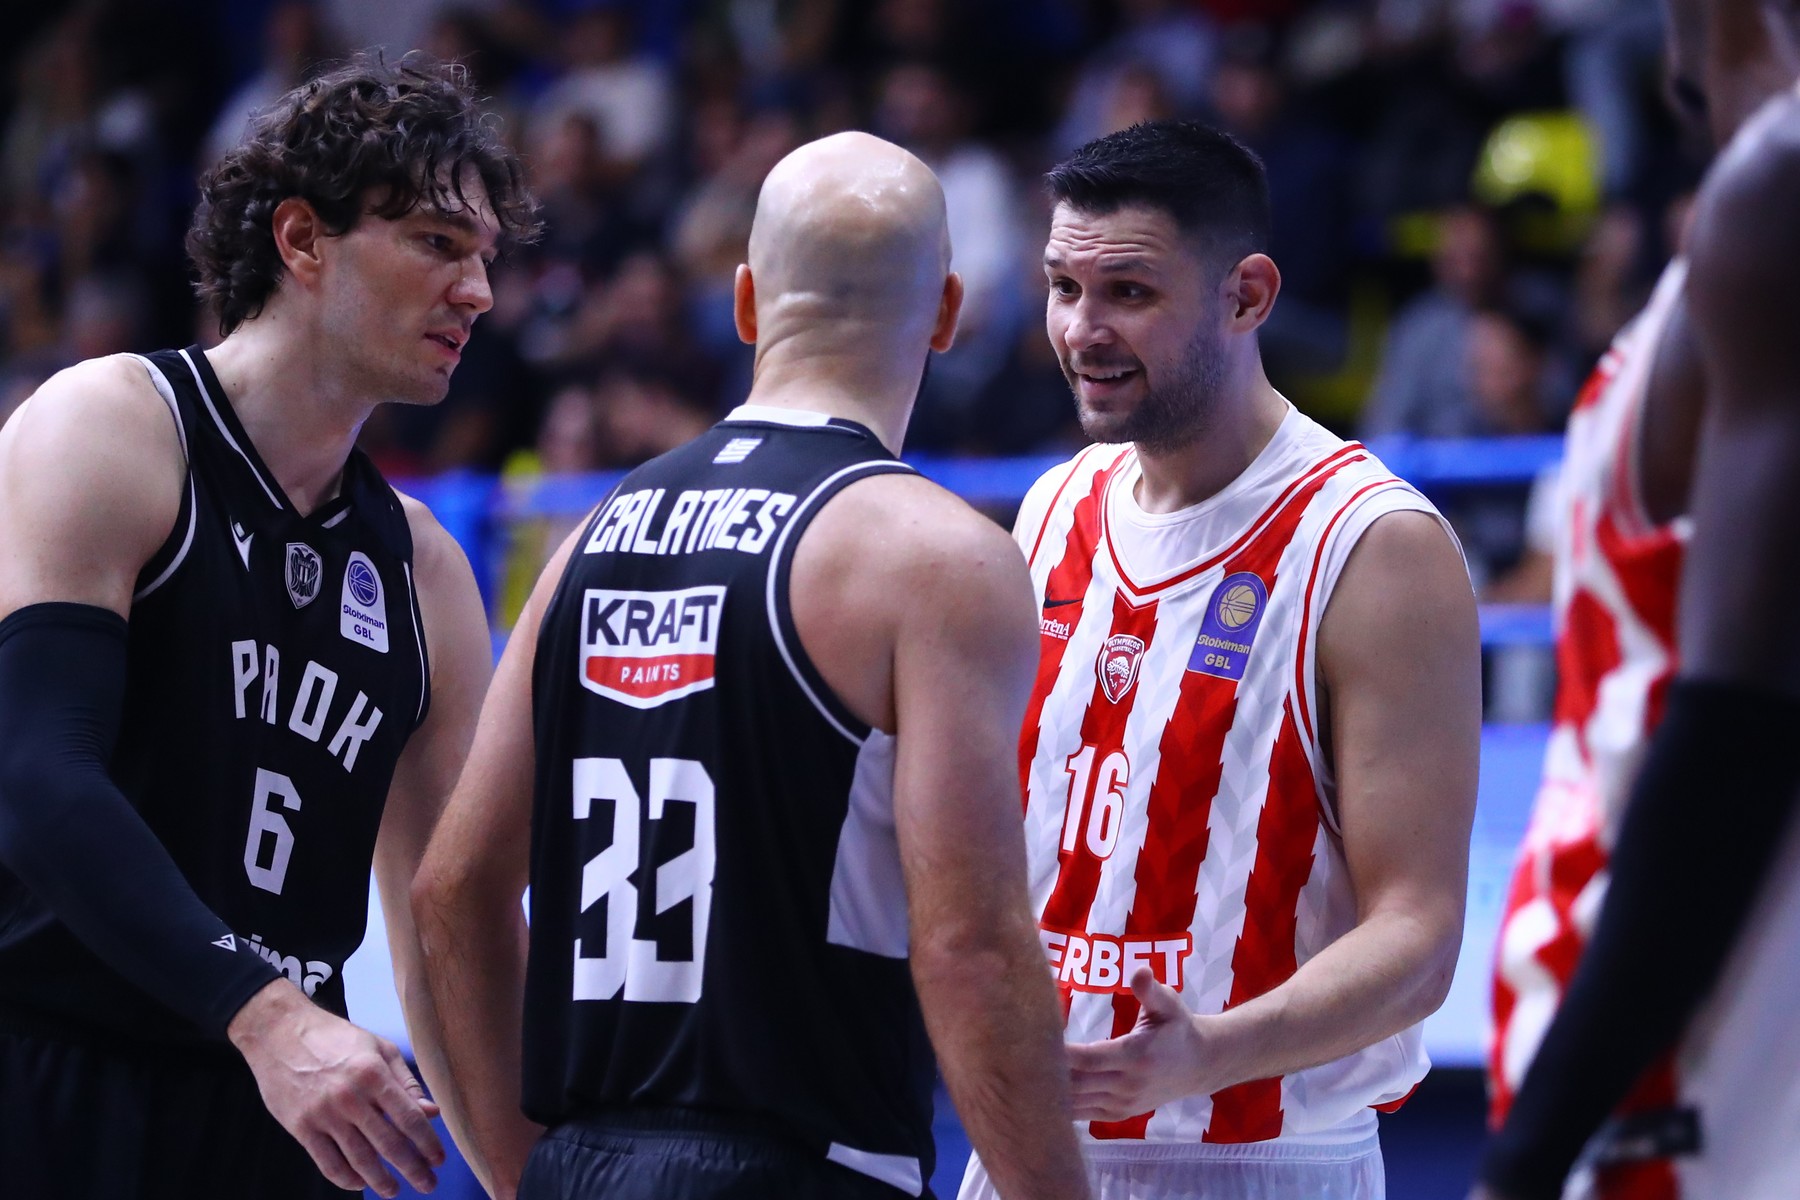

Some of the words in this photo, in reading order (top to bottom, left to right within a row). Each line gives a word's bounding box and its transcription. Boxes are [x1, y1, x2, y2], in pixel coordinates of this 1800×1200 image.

[584, 488, 797, 555] CALATHES
[343, 604, 385, 630] Stoiximan
[353, 624, 375, 642] GBL
[586, 595, 718, 646] KRAFT
[1108, 638, 1141, 650] OLYMPIACOS
[1197, 634, 1250, 654] Stoiximan
[1204, 653, 1231, 670] GBL
[620, 663, 680, 684] PAINTS
[231, 639, 384, 774] PAOK
[1061, 743, 1130, 861] 16
[243, 766, 302, 896] 6
[572, 757, 717, 1004] 33
